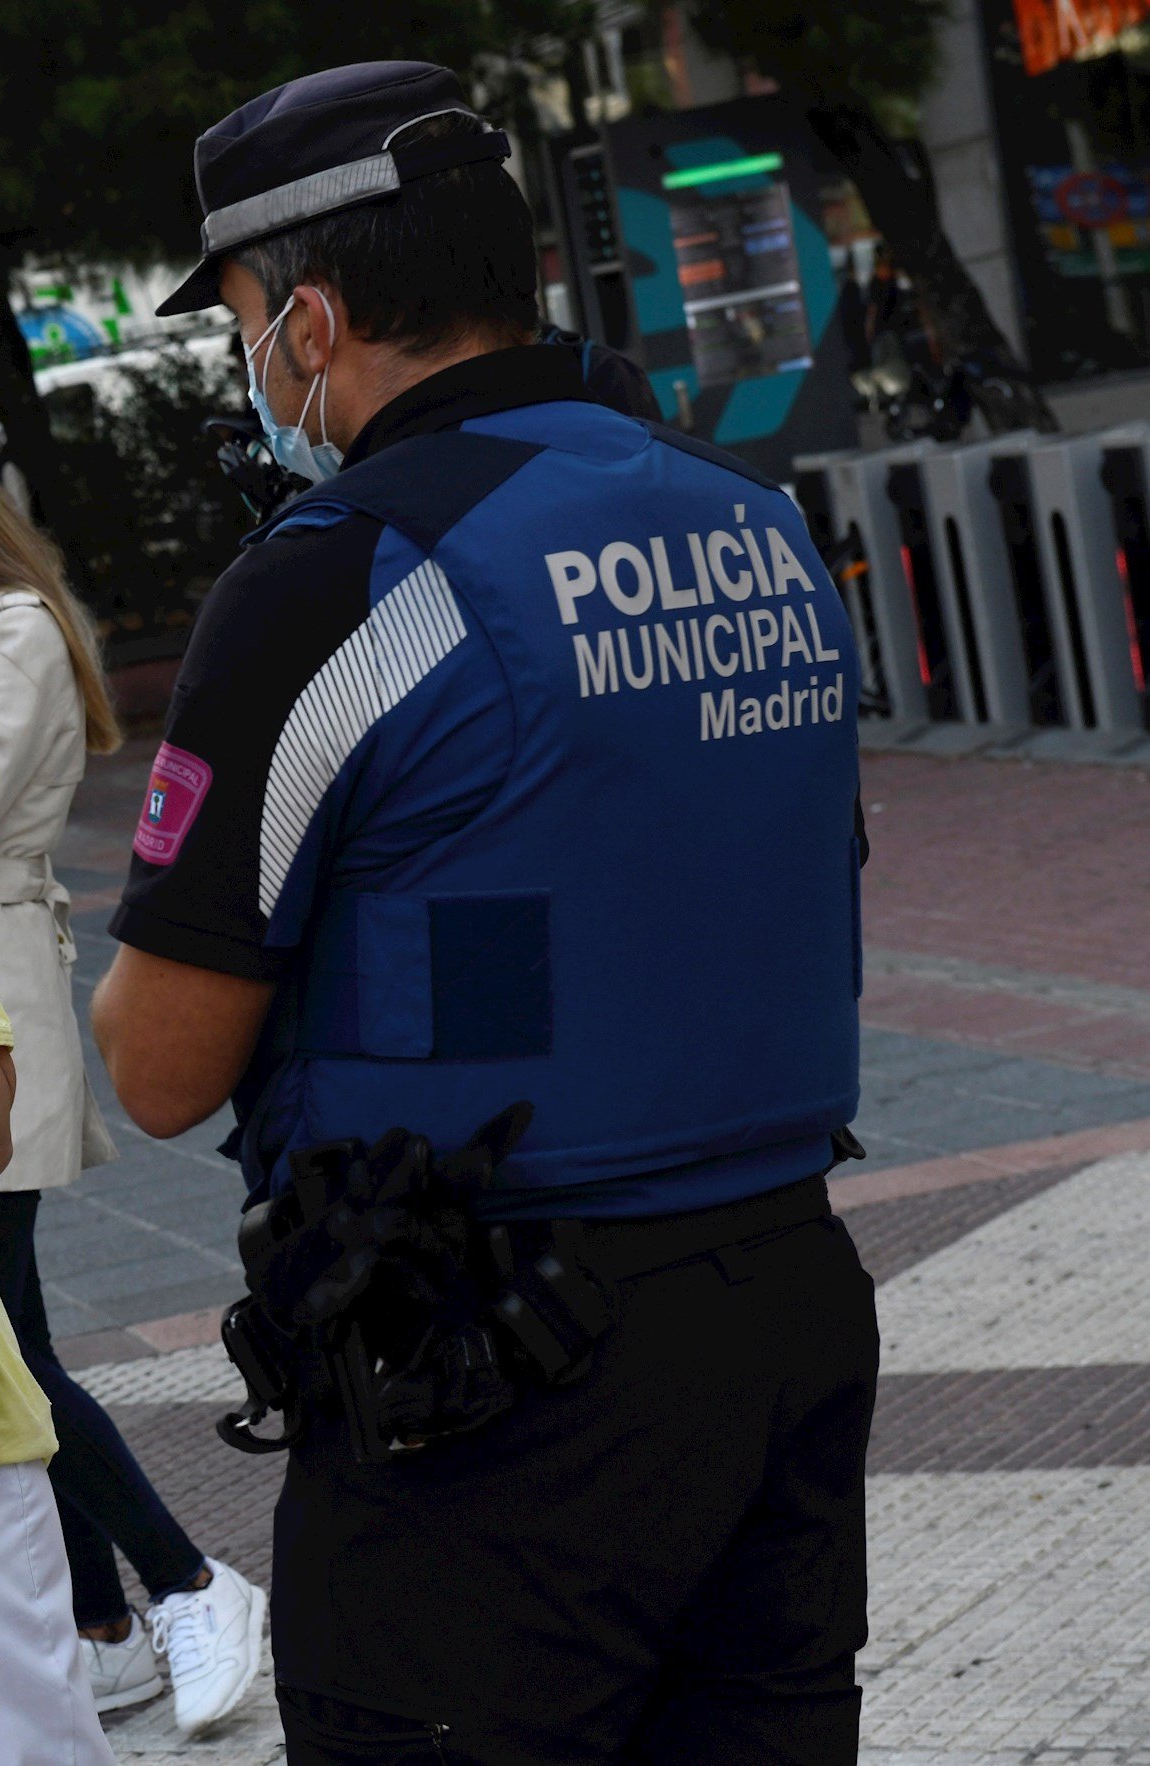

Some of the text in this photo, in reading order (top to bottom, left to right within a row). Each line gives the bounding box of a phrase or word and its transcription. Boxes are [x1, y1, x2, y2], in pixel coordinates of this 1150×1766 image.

[544, 503, 816, 625] POLICÍA
[573, 603, 839, 698] MUNICIPAL
[700, 673, 843, 741] Madrid
